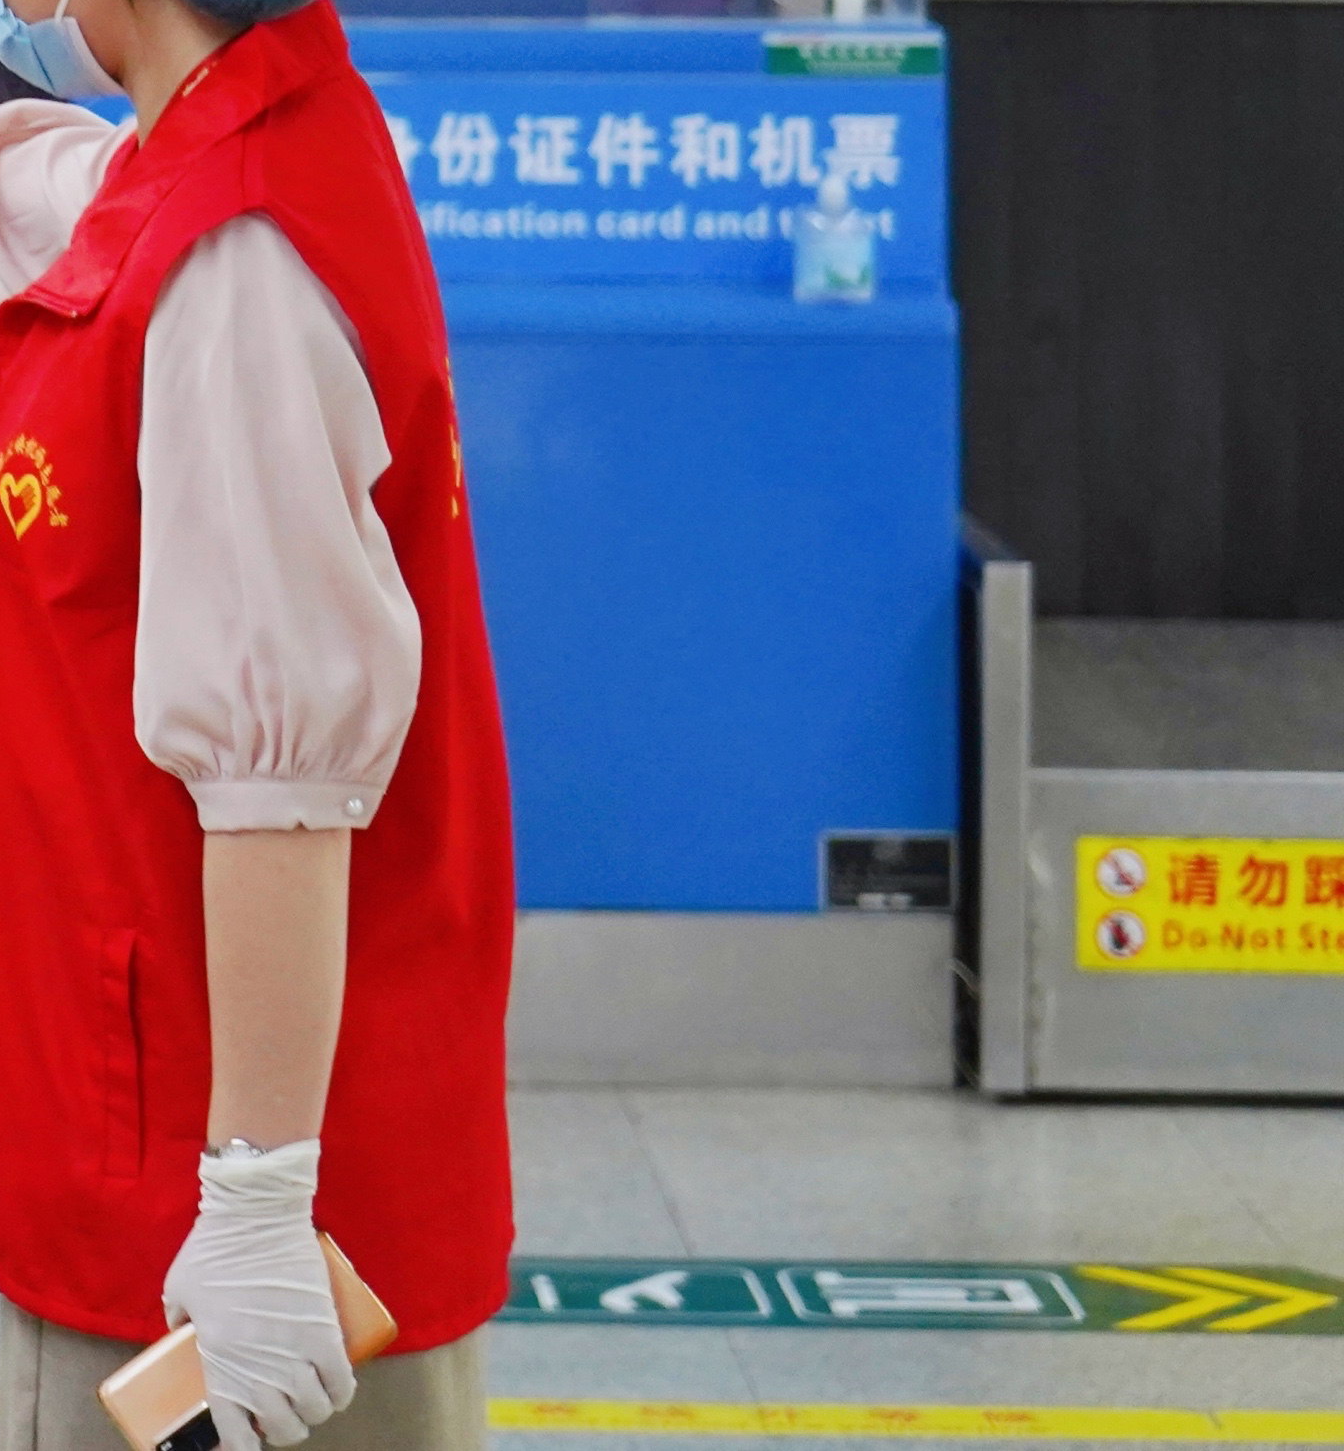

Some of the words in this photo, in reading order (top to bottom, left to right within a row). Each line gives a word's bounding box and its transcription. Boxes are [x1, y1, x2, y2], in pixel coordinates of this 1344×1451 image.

[596, 203, 686, 241] card
[693, 202, 769, 241] and
[1162, 919, 1209, 950] Do
[1219, 922, 1286, 952] Not
